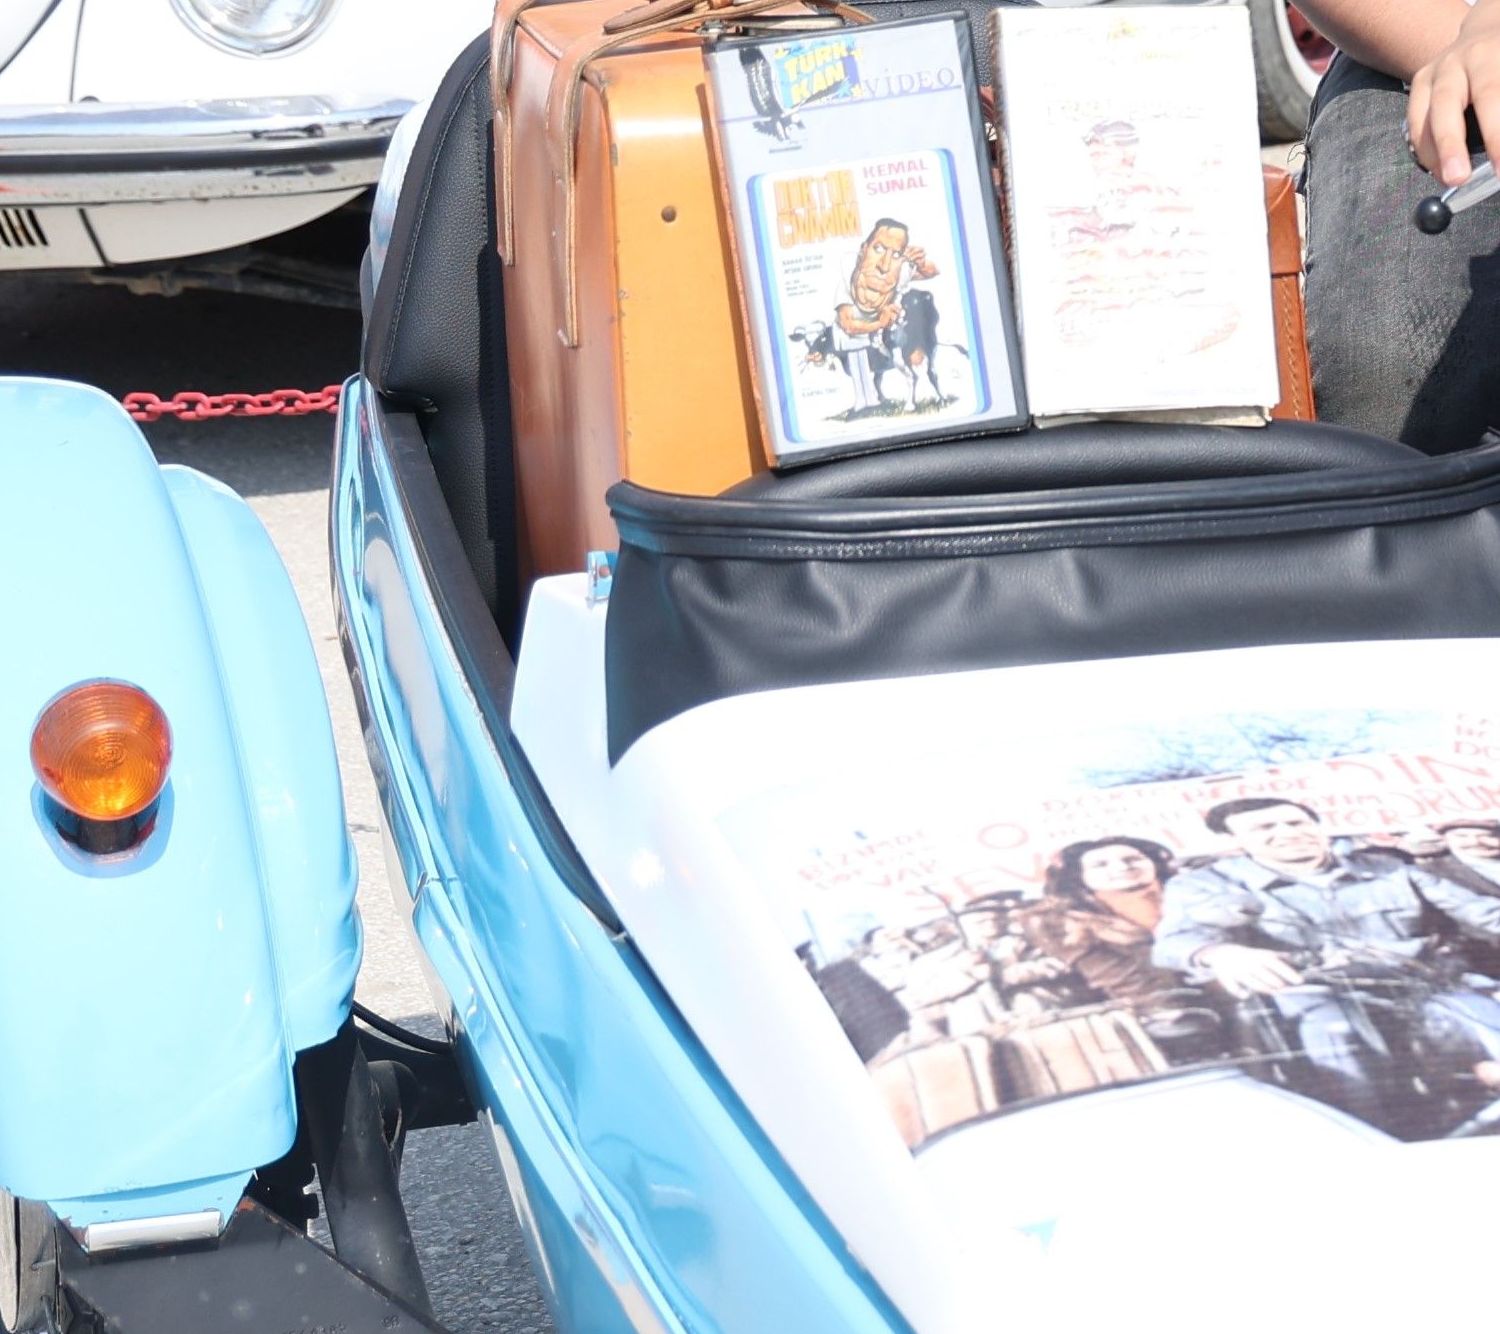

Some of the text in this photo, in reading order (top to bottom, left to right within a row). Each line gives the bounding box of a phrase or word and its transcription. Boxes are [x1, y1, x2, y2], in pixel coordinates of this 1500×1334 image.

[862, 67, 956, 97] VİDEO
[863, 158, 929, 179] KEMAL
[866, 175, 929, 196] SUNAL
